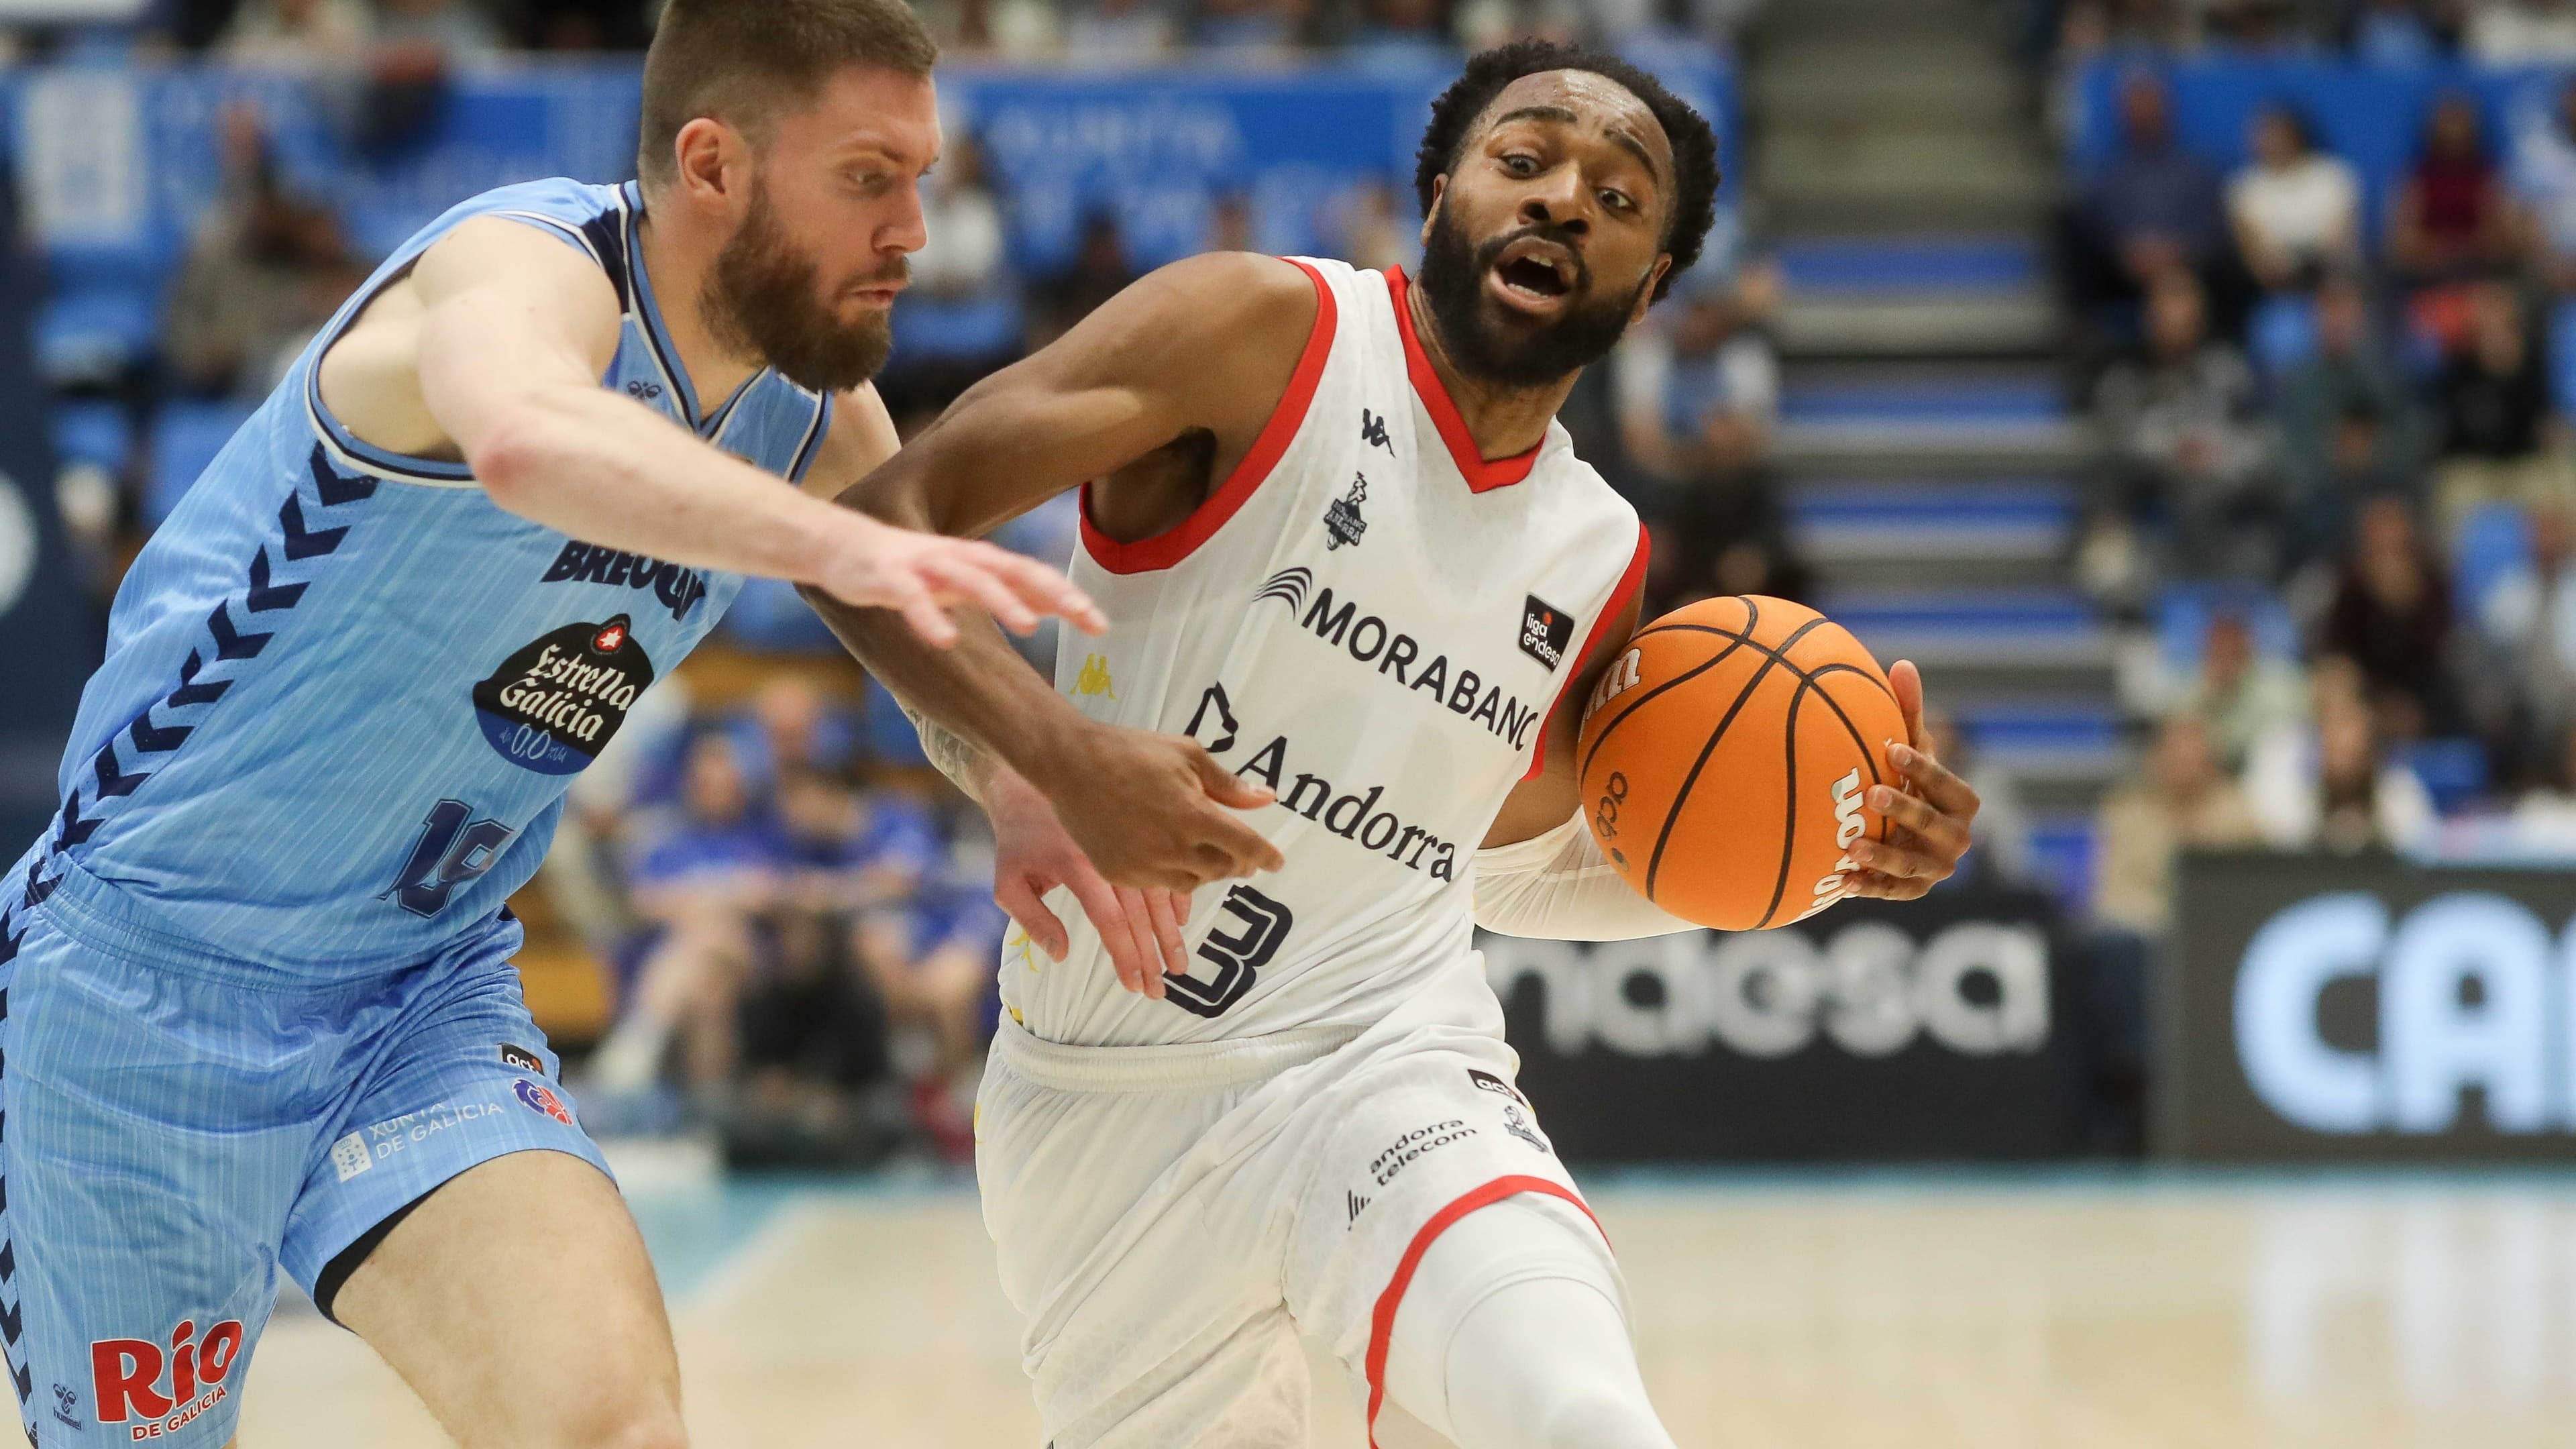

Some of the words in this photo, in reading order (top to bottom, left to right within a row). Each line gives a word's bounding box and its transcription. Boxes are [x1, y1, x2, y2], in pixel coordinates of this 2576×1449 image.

[1523, 632, 1560, 666] endesa
[1526, 612, 1548, 637] liga
[525, 643, 635, 711] Estrella
[1302, 588, 1539, 751] MORABANC
[500, 677, 603, 742] Galicia
[1234, 736, 1456, 883] Andorra
[1164, 883, 1293, 1019] 3
[1479, 920, 2051, 1059] ndesa
[2233, 889, 2576, 1135] CA
[376, 1134, 405, 1160] DE
[411, 1102, 504, 1142] GALICIA
[1369, 1119, 1464, 1175] andorra
[1376, 1128, 1478, 1187] telecom
[91, 1320, 243, 1423] Río
[132, 1423, 162, 1441] DE
[166, 1385, 227, 1432] GALICIA
